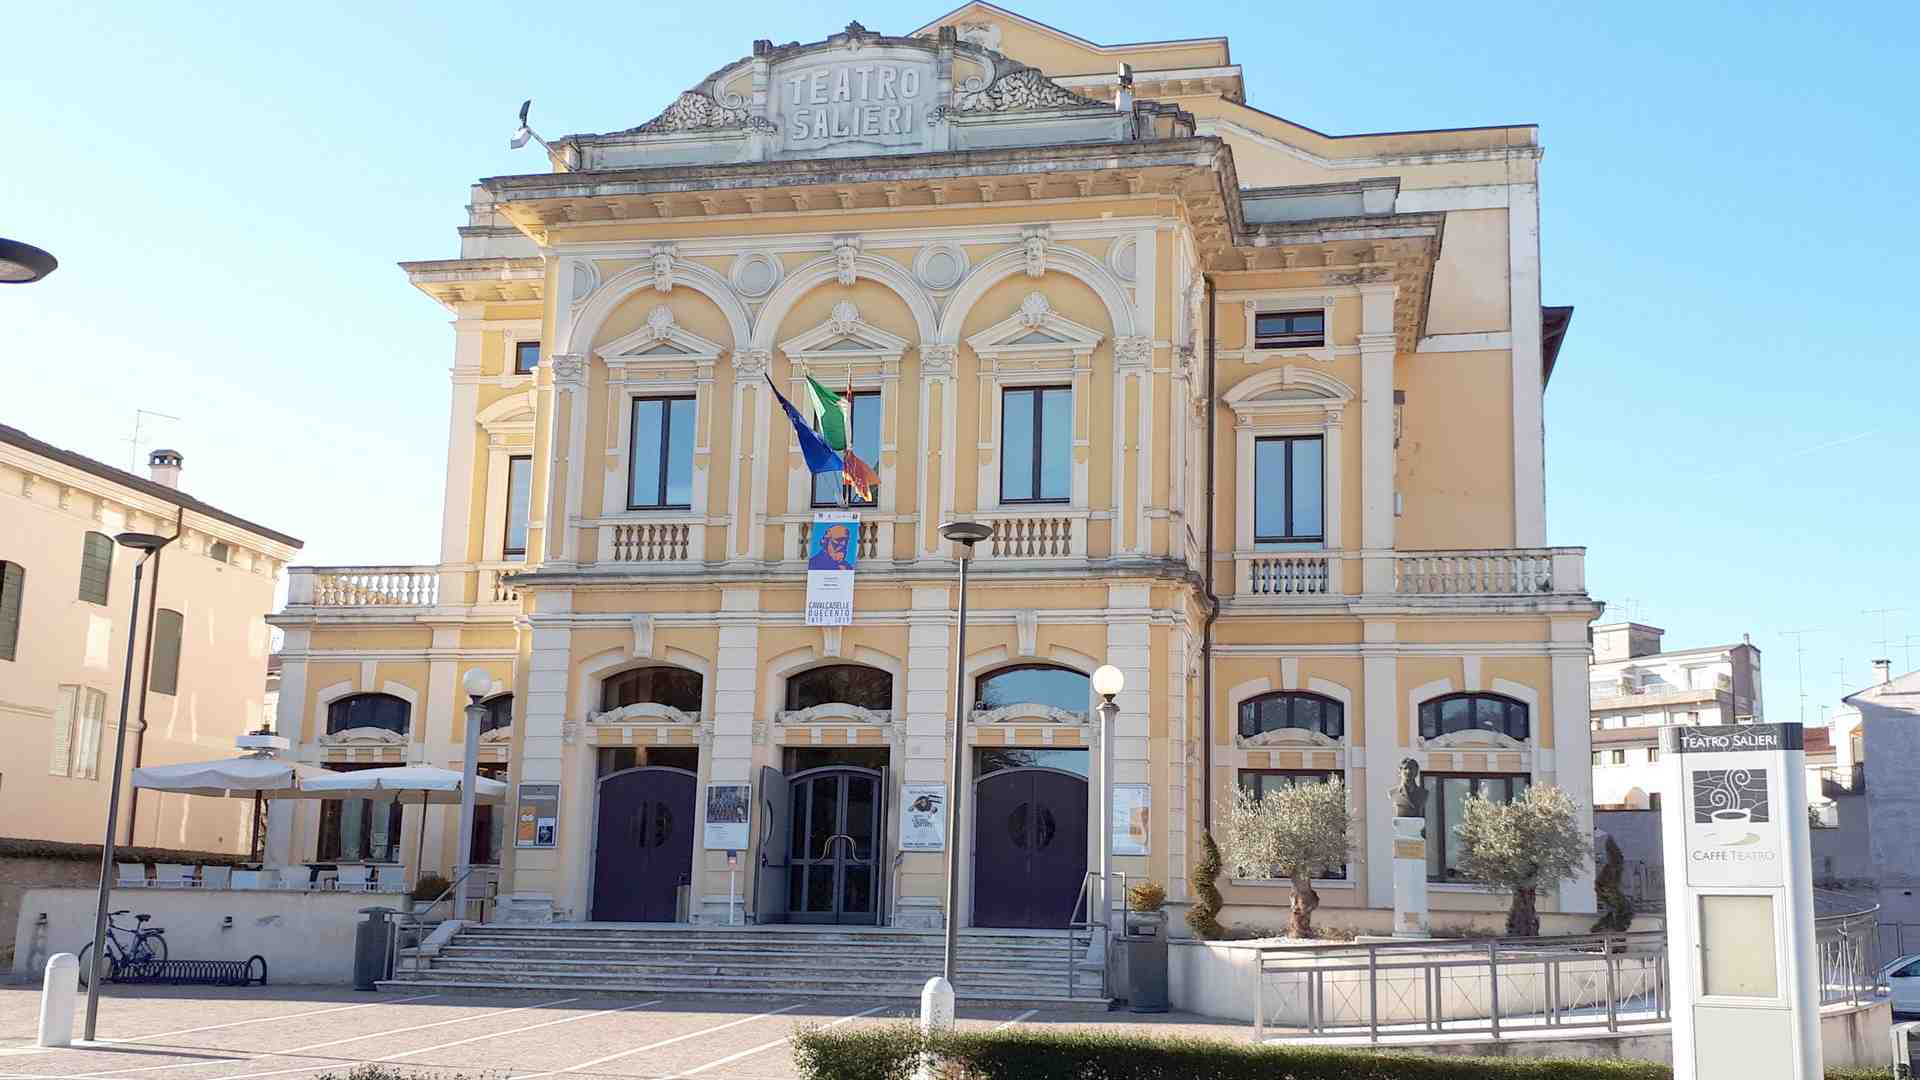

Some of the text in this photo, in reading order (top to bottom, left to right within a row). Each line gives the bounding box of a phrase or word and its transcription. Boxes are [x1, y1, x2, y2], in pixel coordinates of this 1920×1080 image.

[785, 65, 920, 105] TEATRO
[792, 104, 913, 140] SALIERI
[1680, 734, 1777, 748] TEATRO SALIERI
[1729, 850, 1775, 861] TEATRO
